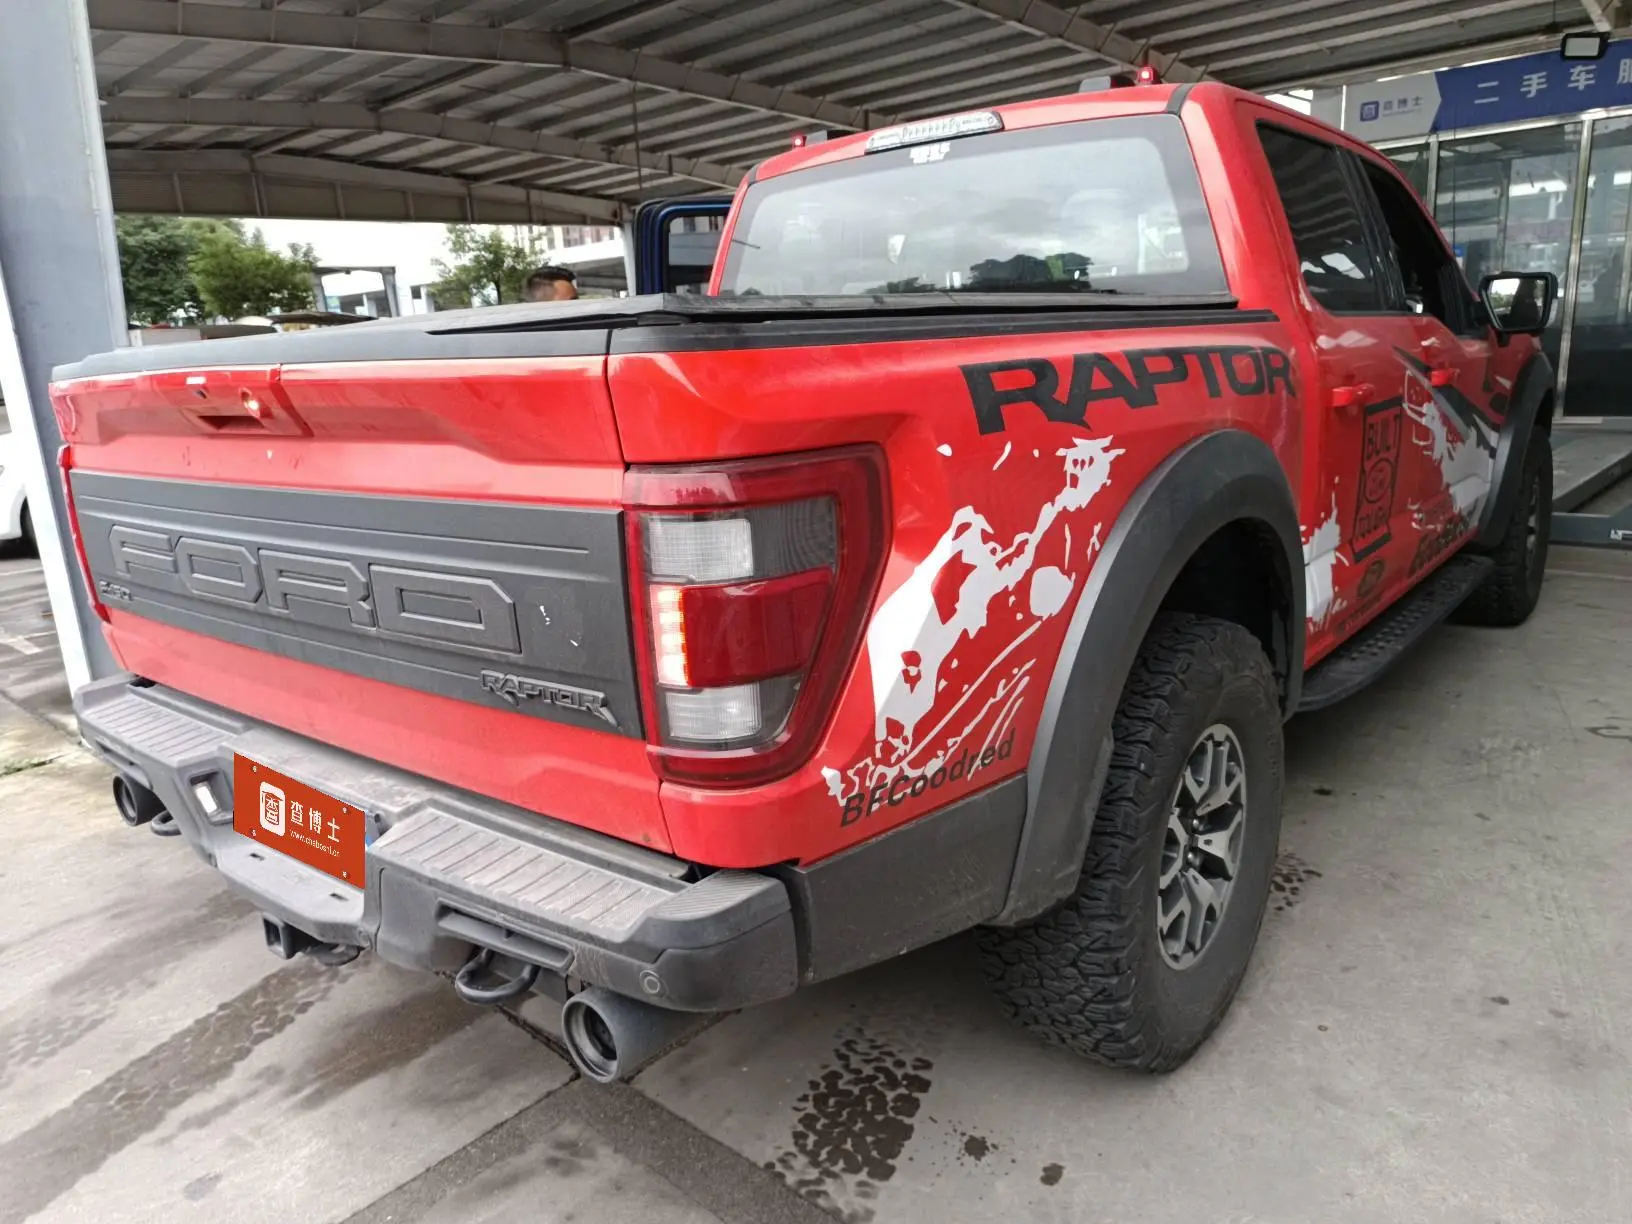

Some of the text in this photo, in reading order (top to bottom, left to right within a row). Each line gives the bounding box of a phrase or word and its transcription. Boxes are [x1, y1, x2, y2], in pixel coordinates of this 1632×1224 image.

[960, 345, 1296, 435] RAPTOR
[1366, 413, 1401, 460] BUILT
[109, 524, 523, 655] FORD
[480, 669, 621, 730] RAPTOR
